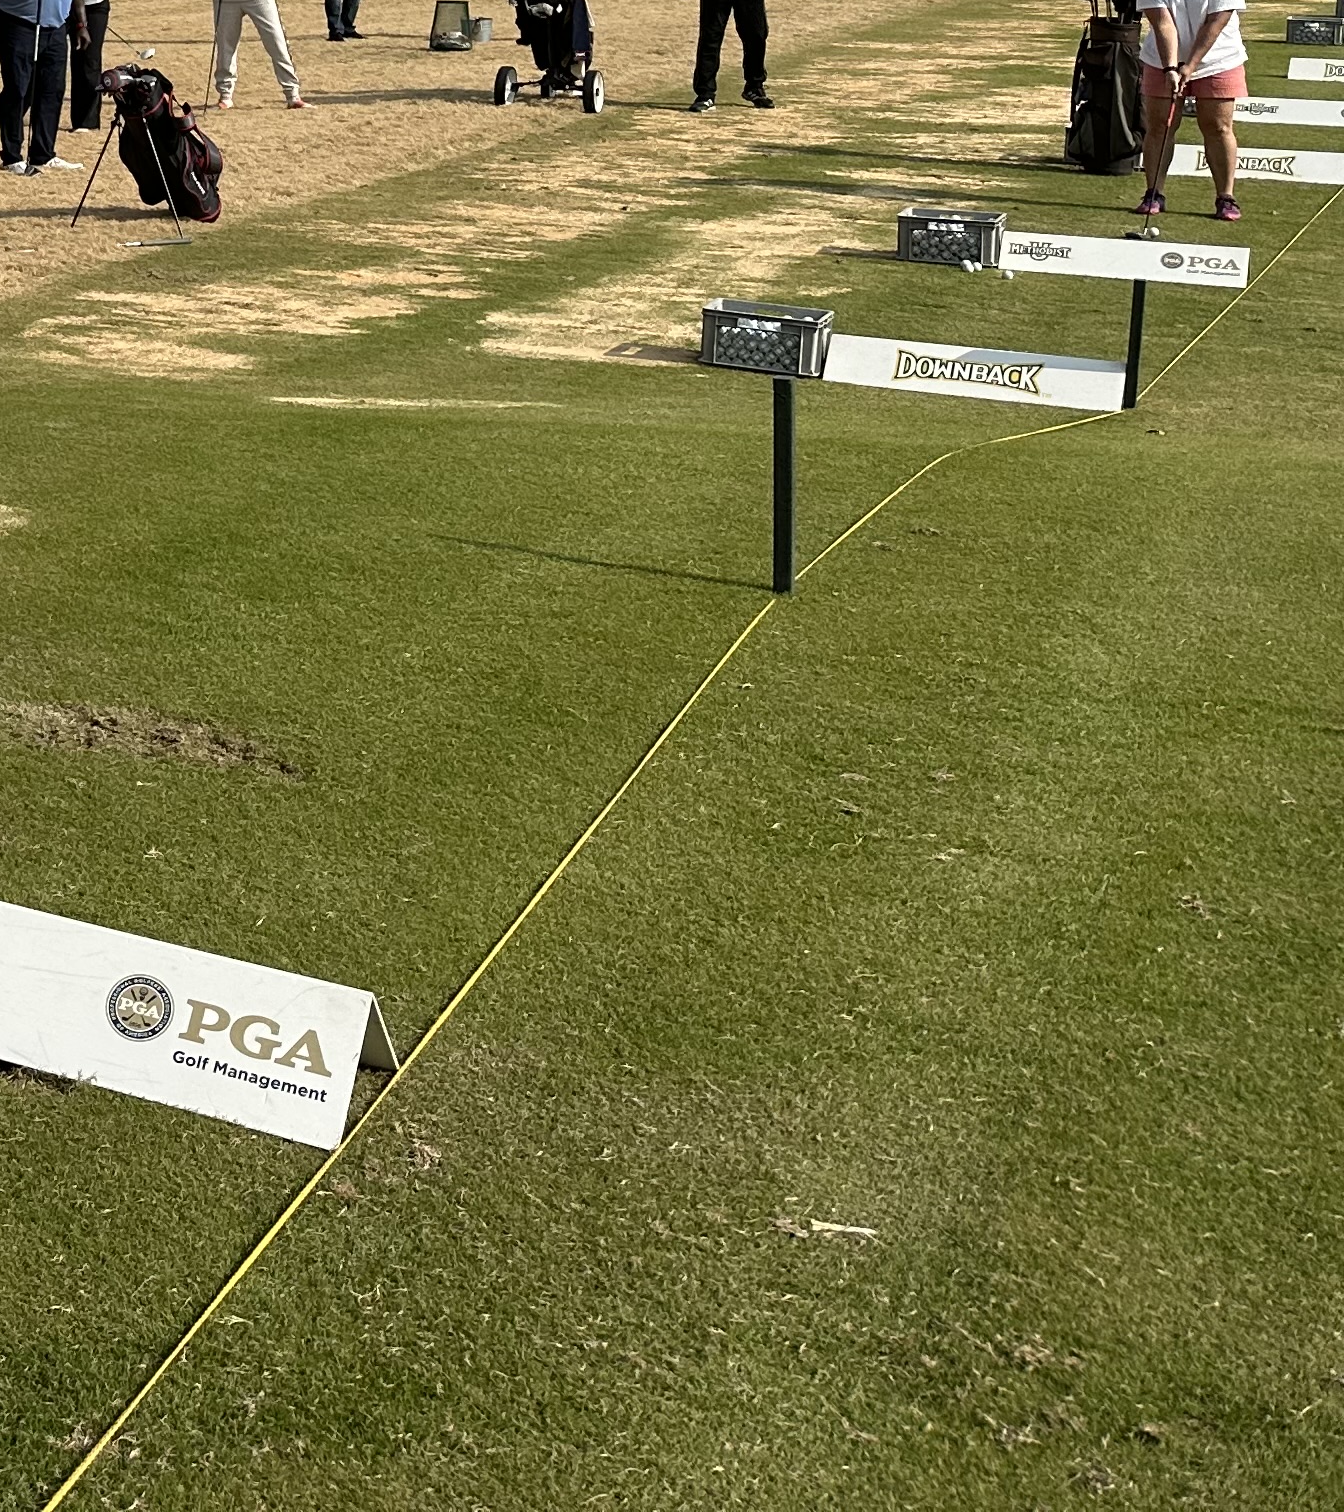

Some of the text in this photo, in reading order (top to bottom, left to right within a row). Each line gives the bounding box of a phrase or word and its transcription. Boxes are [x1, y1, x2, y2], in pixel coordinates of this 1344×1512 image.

[1008, 242, 1072, 259] METHODIST
[1187, 255, 1241, 270] PGA
[893, 349, 1044, 394] DOWNBACK
[118, 997, 160, 1019] PGA
[178, 998, 332, 1078] PGA
[172, 1050, 328, 1103] Golf Management
